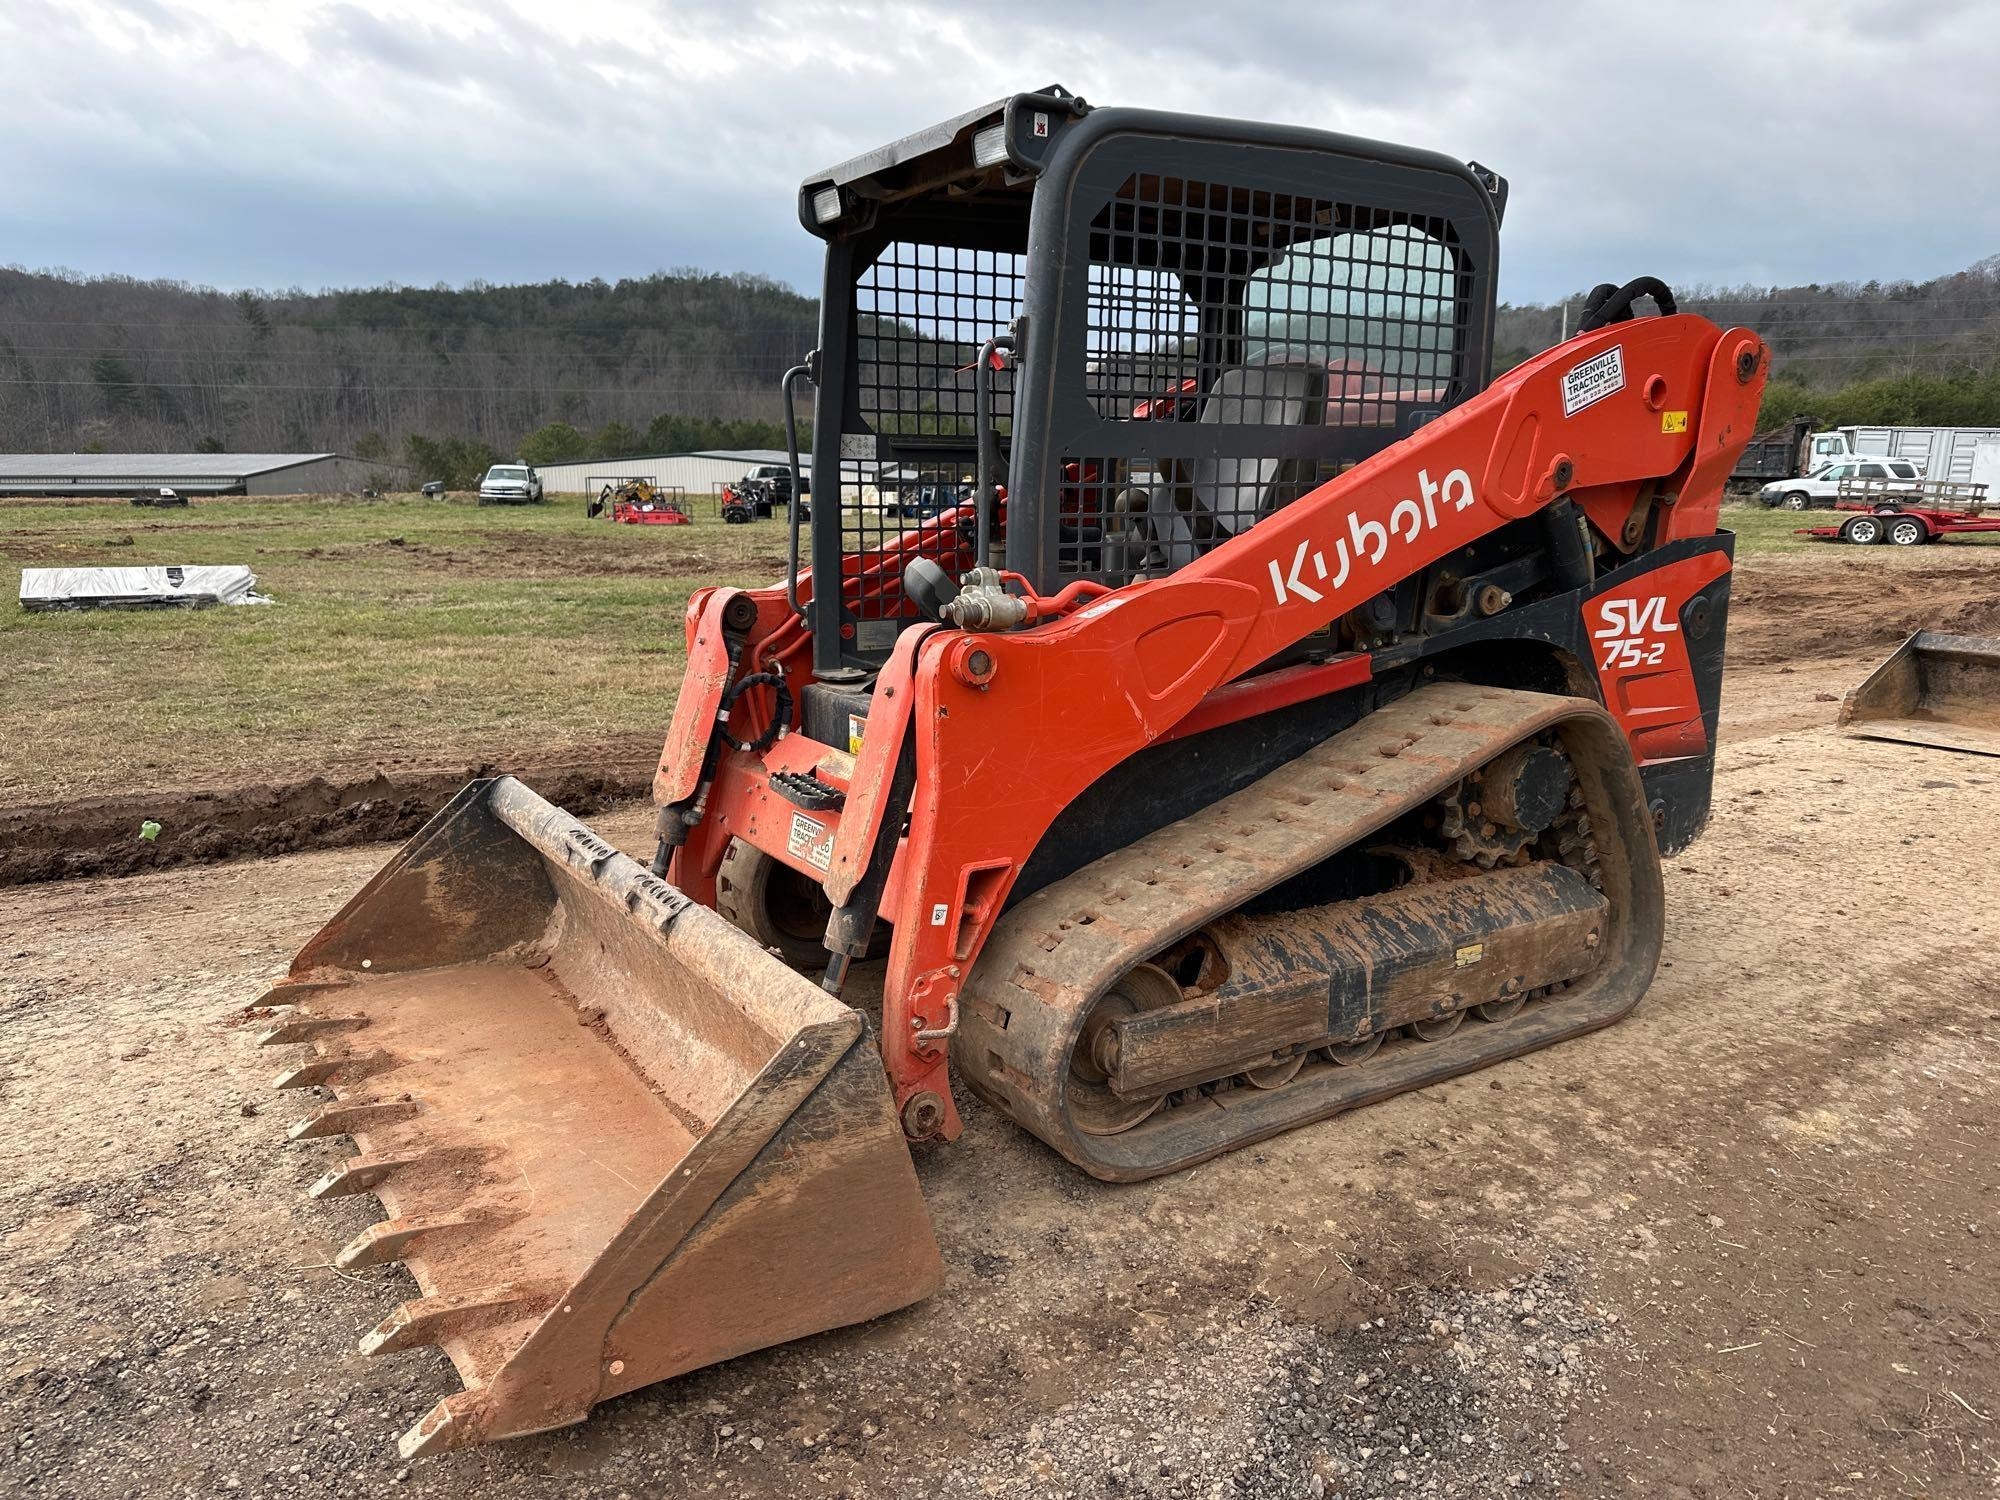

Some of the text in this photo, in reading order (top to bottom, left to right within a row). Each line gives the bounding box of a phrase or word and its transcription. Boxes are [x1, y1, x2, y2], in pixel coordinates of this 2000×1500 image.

[1567, 364, 1619, 395] TRACTOR CO
[1568, 353, 1617, 384] GREENVILLE
[1268, 469, 1475, 606] Kubota
[1594, 596, 1679, 639] SVL
[1600, 637, 1666, 671] 75-2
